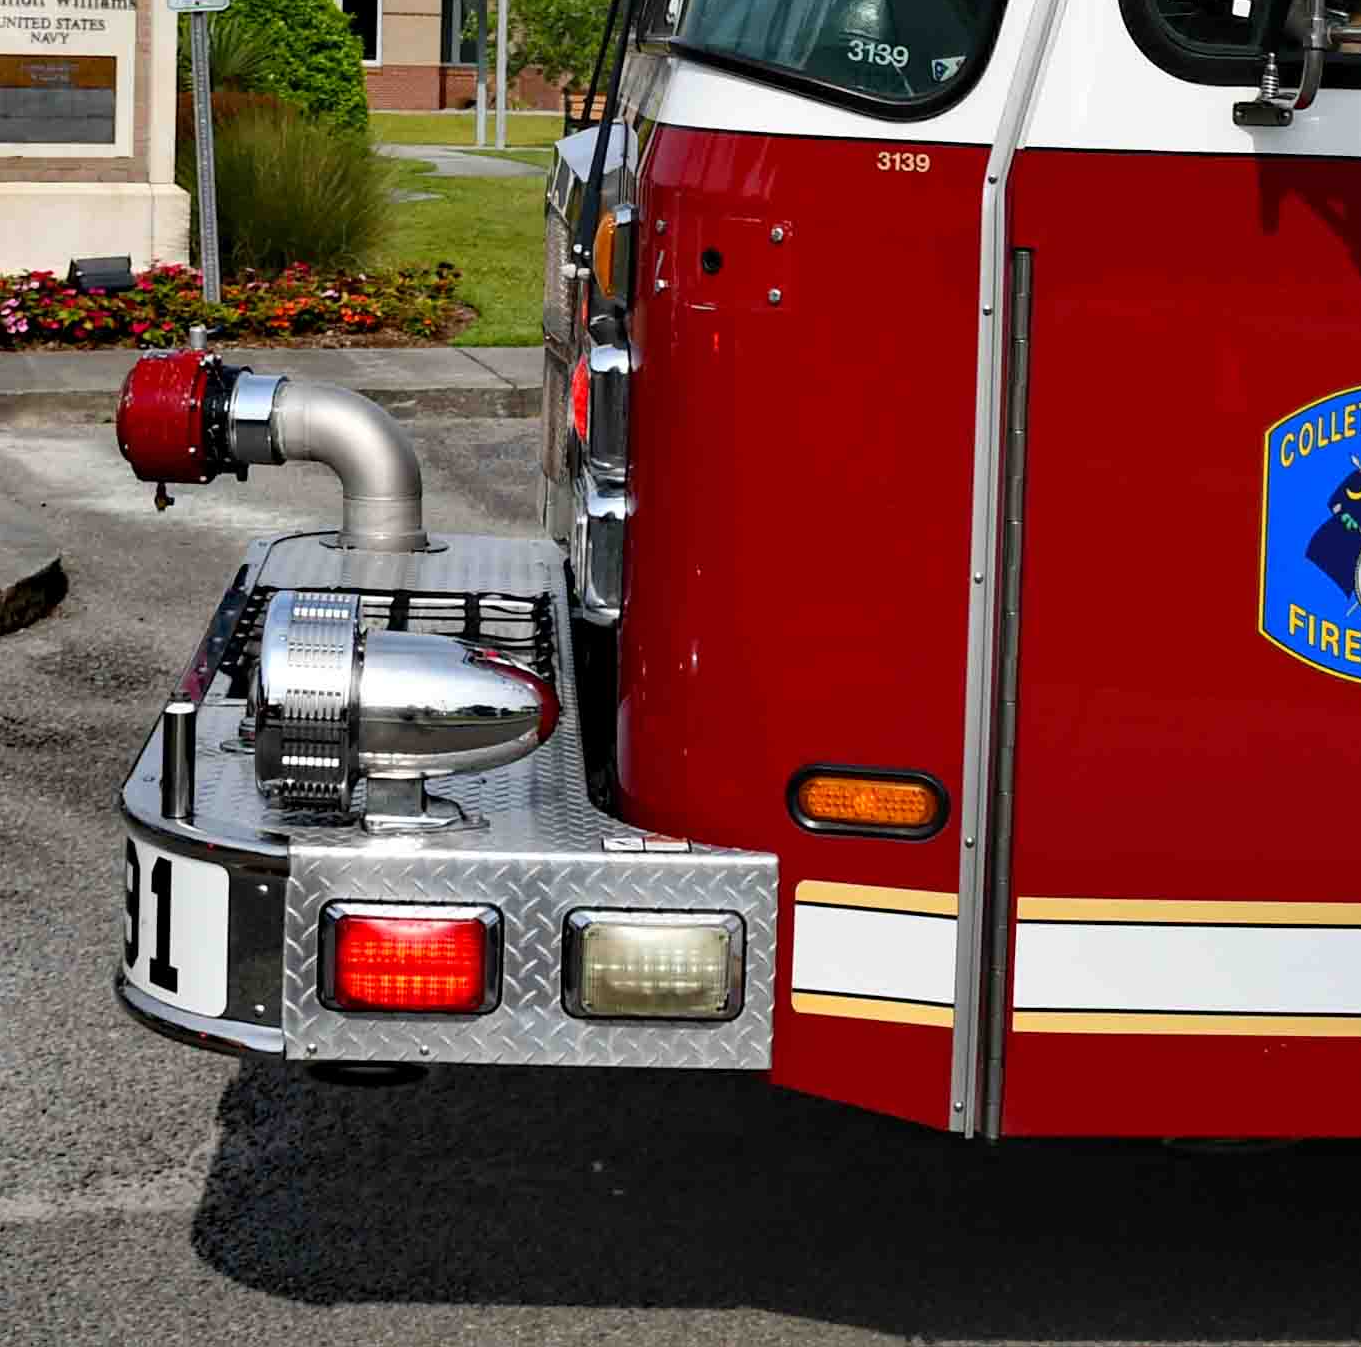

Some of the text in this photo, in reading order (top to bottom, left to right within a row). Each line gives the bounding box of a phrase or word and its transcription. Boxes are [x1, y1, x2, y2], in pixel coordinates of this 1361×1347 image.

[55, 17, 106, 31] STATES
[30, 32, 70, 45] NAVY
[847, 39, 909, 68] 3139
[876, 151, 931, 173] 3139
